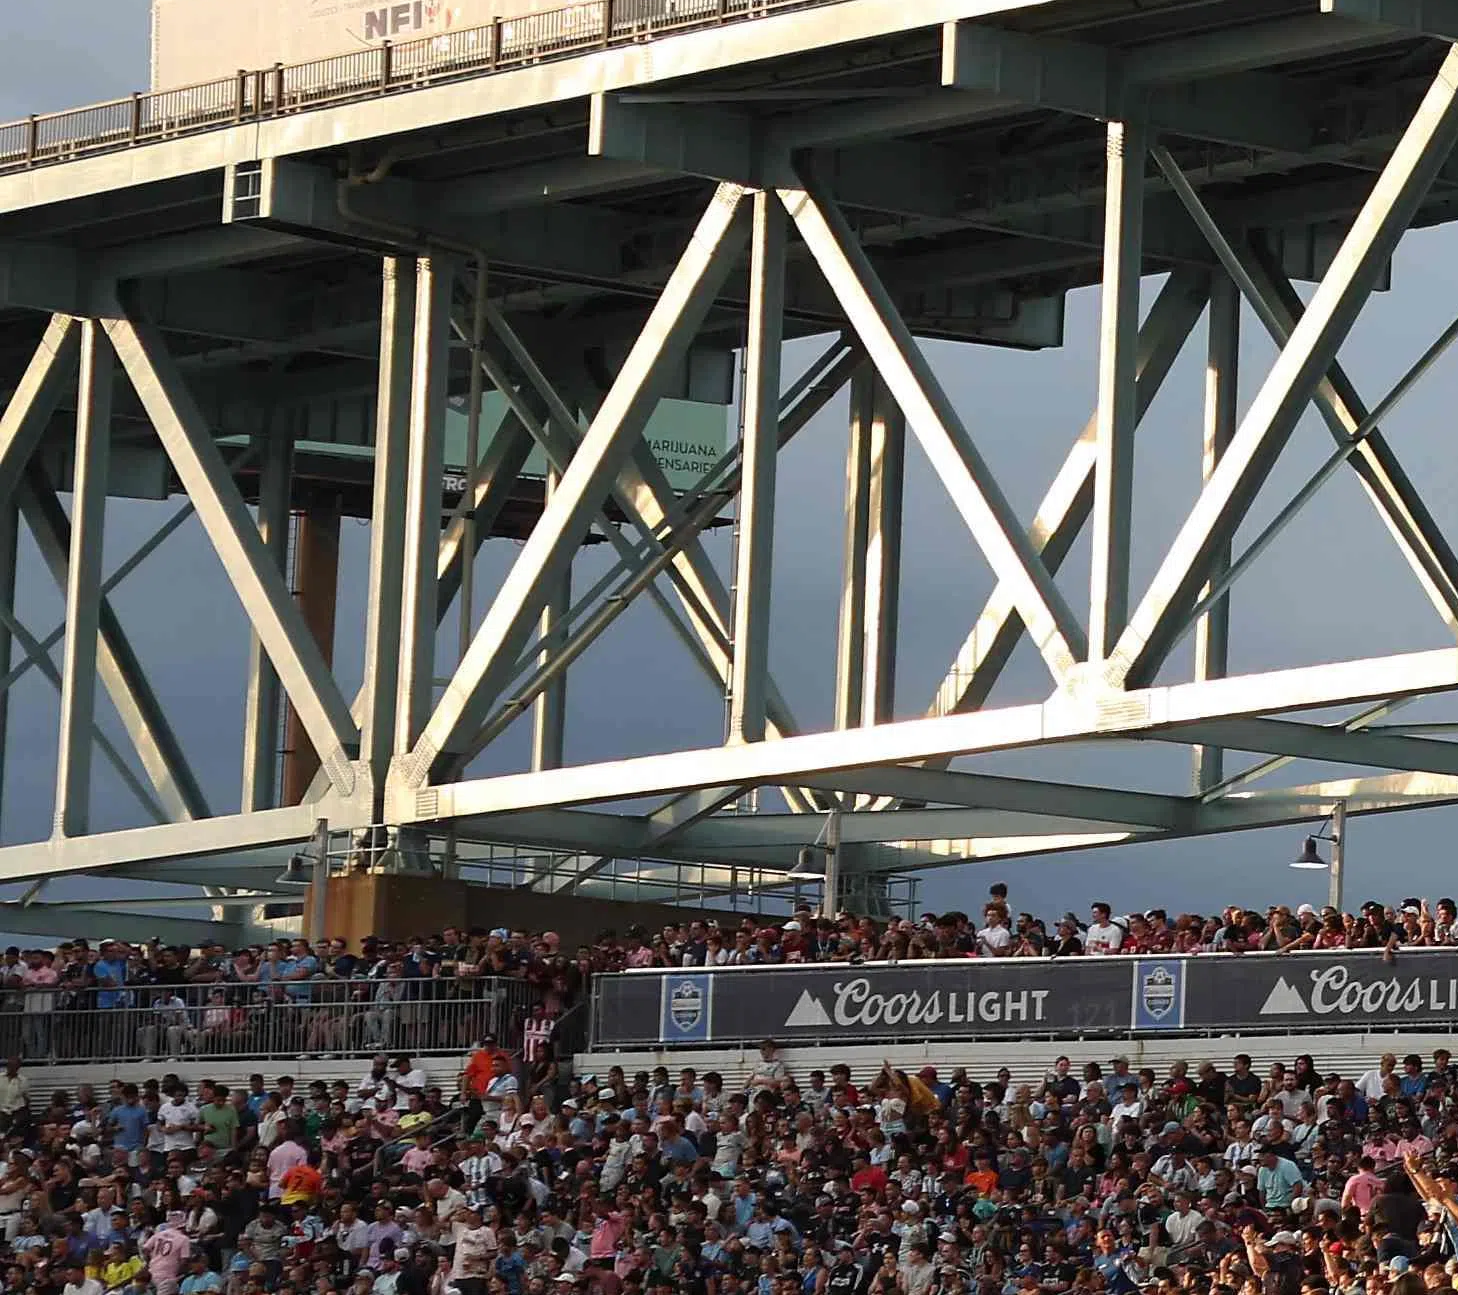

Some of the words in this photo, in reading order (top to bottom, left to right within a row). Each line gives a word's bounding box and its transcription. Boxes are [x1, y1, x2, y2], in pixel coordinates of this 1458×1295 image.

[364, 0, 423, 41] NFI
[833, 977, 945, 1026] Coors
[948, 989, 1050, 1023] LIGHT
[1311, 965, 1425, 1015] Coors
[155, 1238, 173, 1257] 10
